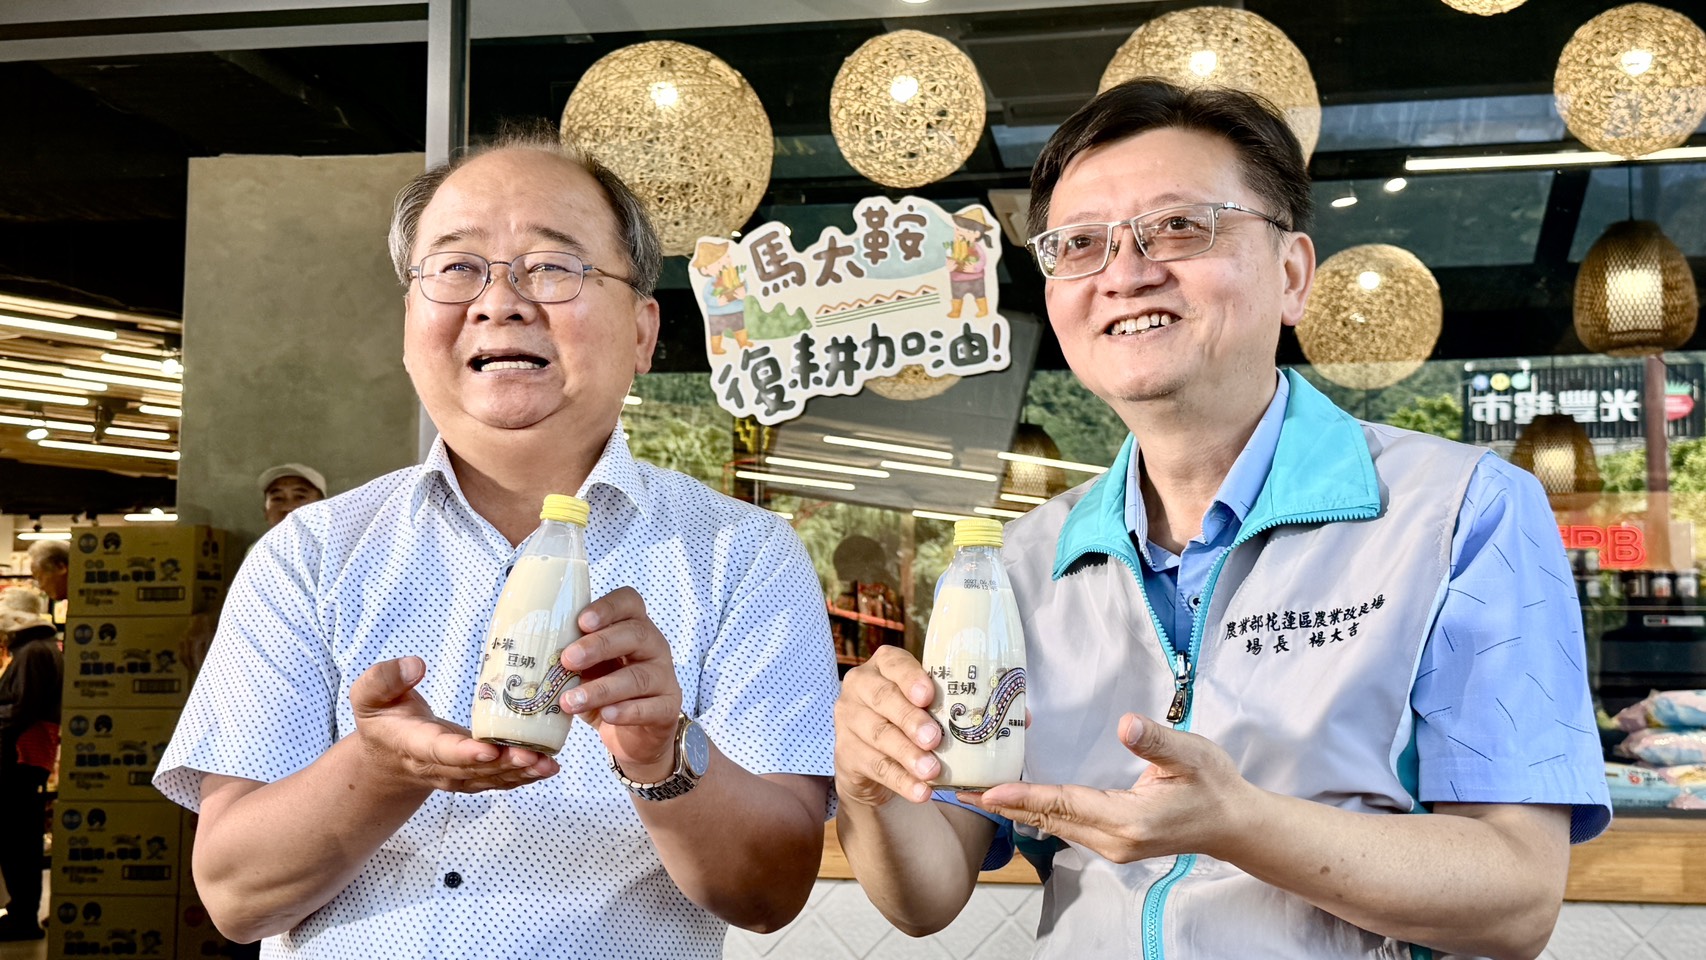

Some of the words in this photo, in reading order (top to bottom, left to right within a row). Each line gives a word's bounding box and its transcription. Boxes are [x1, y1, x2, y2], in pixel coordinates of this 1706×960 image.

[748, 204, 927, 297] 馬太鞍
[718, 322, 1002, 417] 復耕加油!
[1224, 594, 1386, 641] 農業部花蓮區農業改良場
[491, 637, 515, 651] 小米
[1246, 634, 1290, 656] 場長
[1309, 622, 1360, 648] 楊大吉
[506, 652, 537, 669] 豆奶
[947, 680, 977, 696] 豆奶
